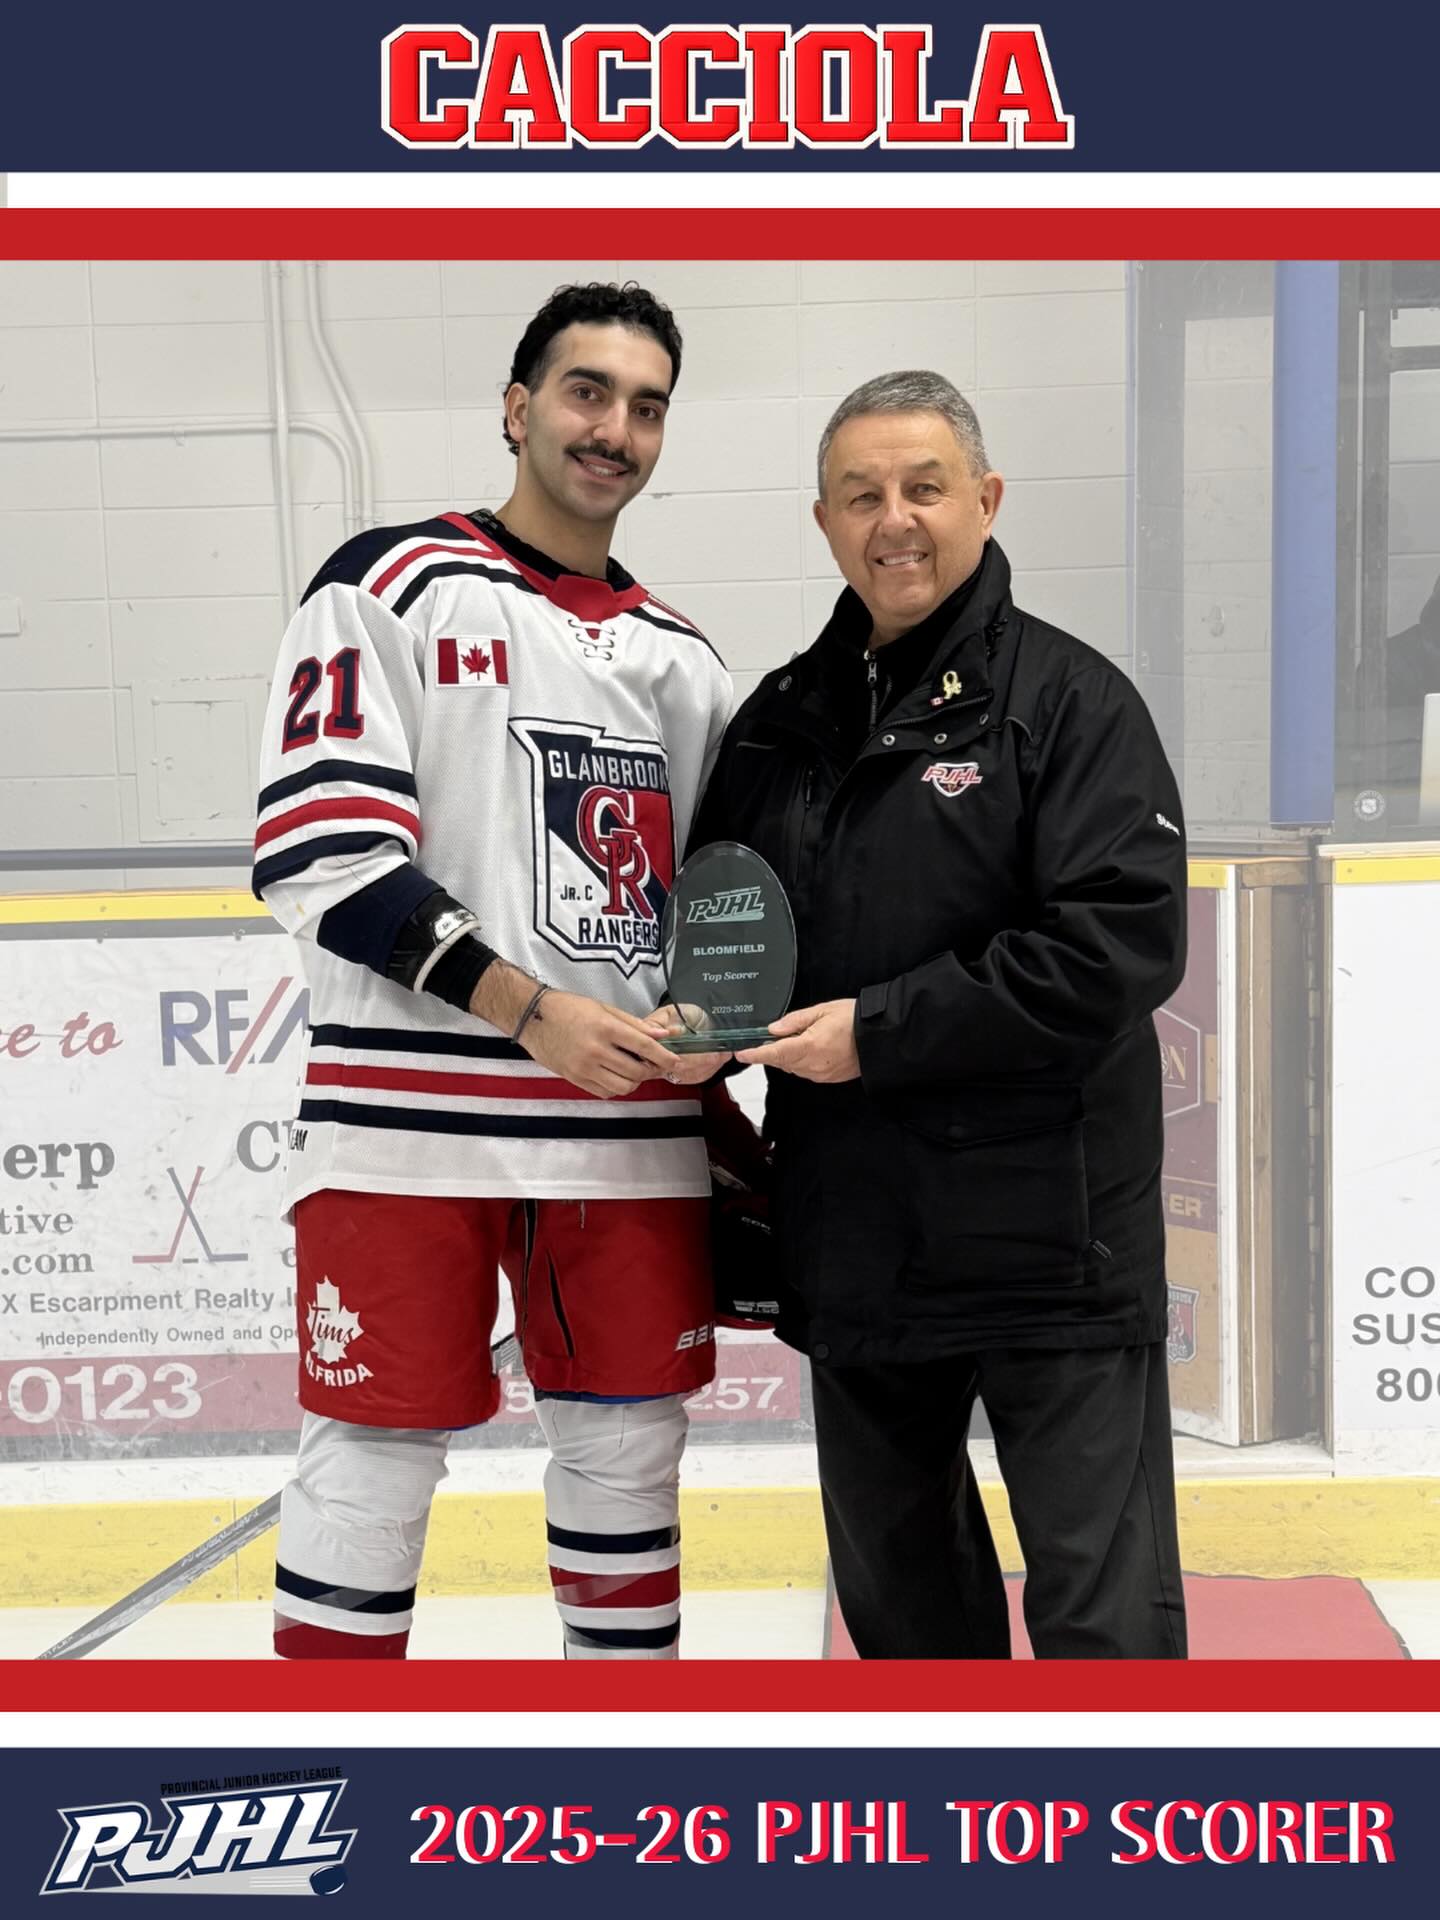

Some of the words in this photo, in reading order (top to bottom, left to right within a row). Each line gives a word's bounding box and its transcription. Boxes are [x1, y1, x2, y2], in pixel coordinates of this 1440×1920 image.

[282, 647, 364, 755] 21
[920, 765, 983, 785] PJHL
[585, 885, 593, 901] C
[686, 890, 765, 923] PJHL
[579, 917, 660, 949] RANGERS
[693, 944, 765, 956] BLOOMFIELD
[702, 971, 722, 983] Top
[724, 971, 759, 981] Scorer
[711, 1004, 754, 1016] 2025-2026
[0, 1024, 40, 1058] e
[59, 1011, 123, 1058] to
[3, 1142, 115, 1190] erp
[0, 1205, 73, 1235] tive
[1168, 1193, 1201, 1219] ER
[1, 1253, 95, 1275] .com
[1365, 1266, 1436, 1298] CO
[2, 1293, 19, 1314] X
[30, 1292, 183, 1316] Escarpment
[195, 1288, 275, 1312] Realty
[40, 1328, 159, 1348] Independently
[167, 1325, 224, 1343] Owned
[233, 1326, 262, 1340] and
[270, 1325, 297, 1343] Op
[311, 1306, 354, 1345] Tims
[1352, 1313, 1440, 1345] SUS
[0, 1362, 202, 1423] 0123
[1376, 1367, 1440, 1402] 80
